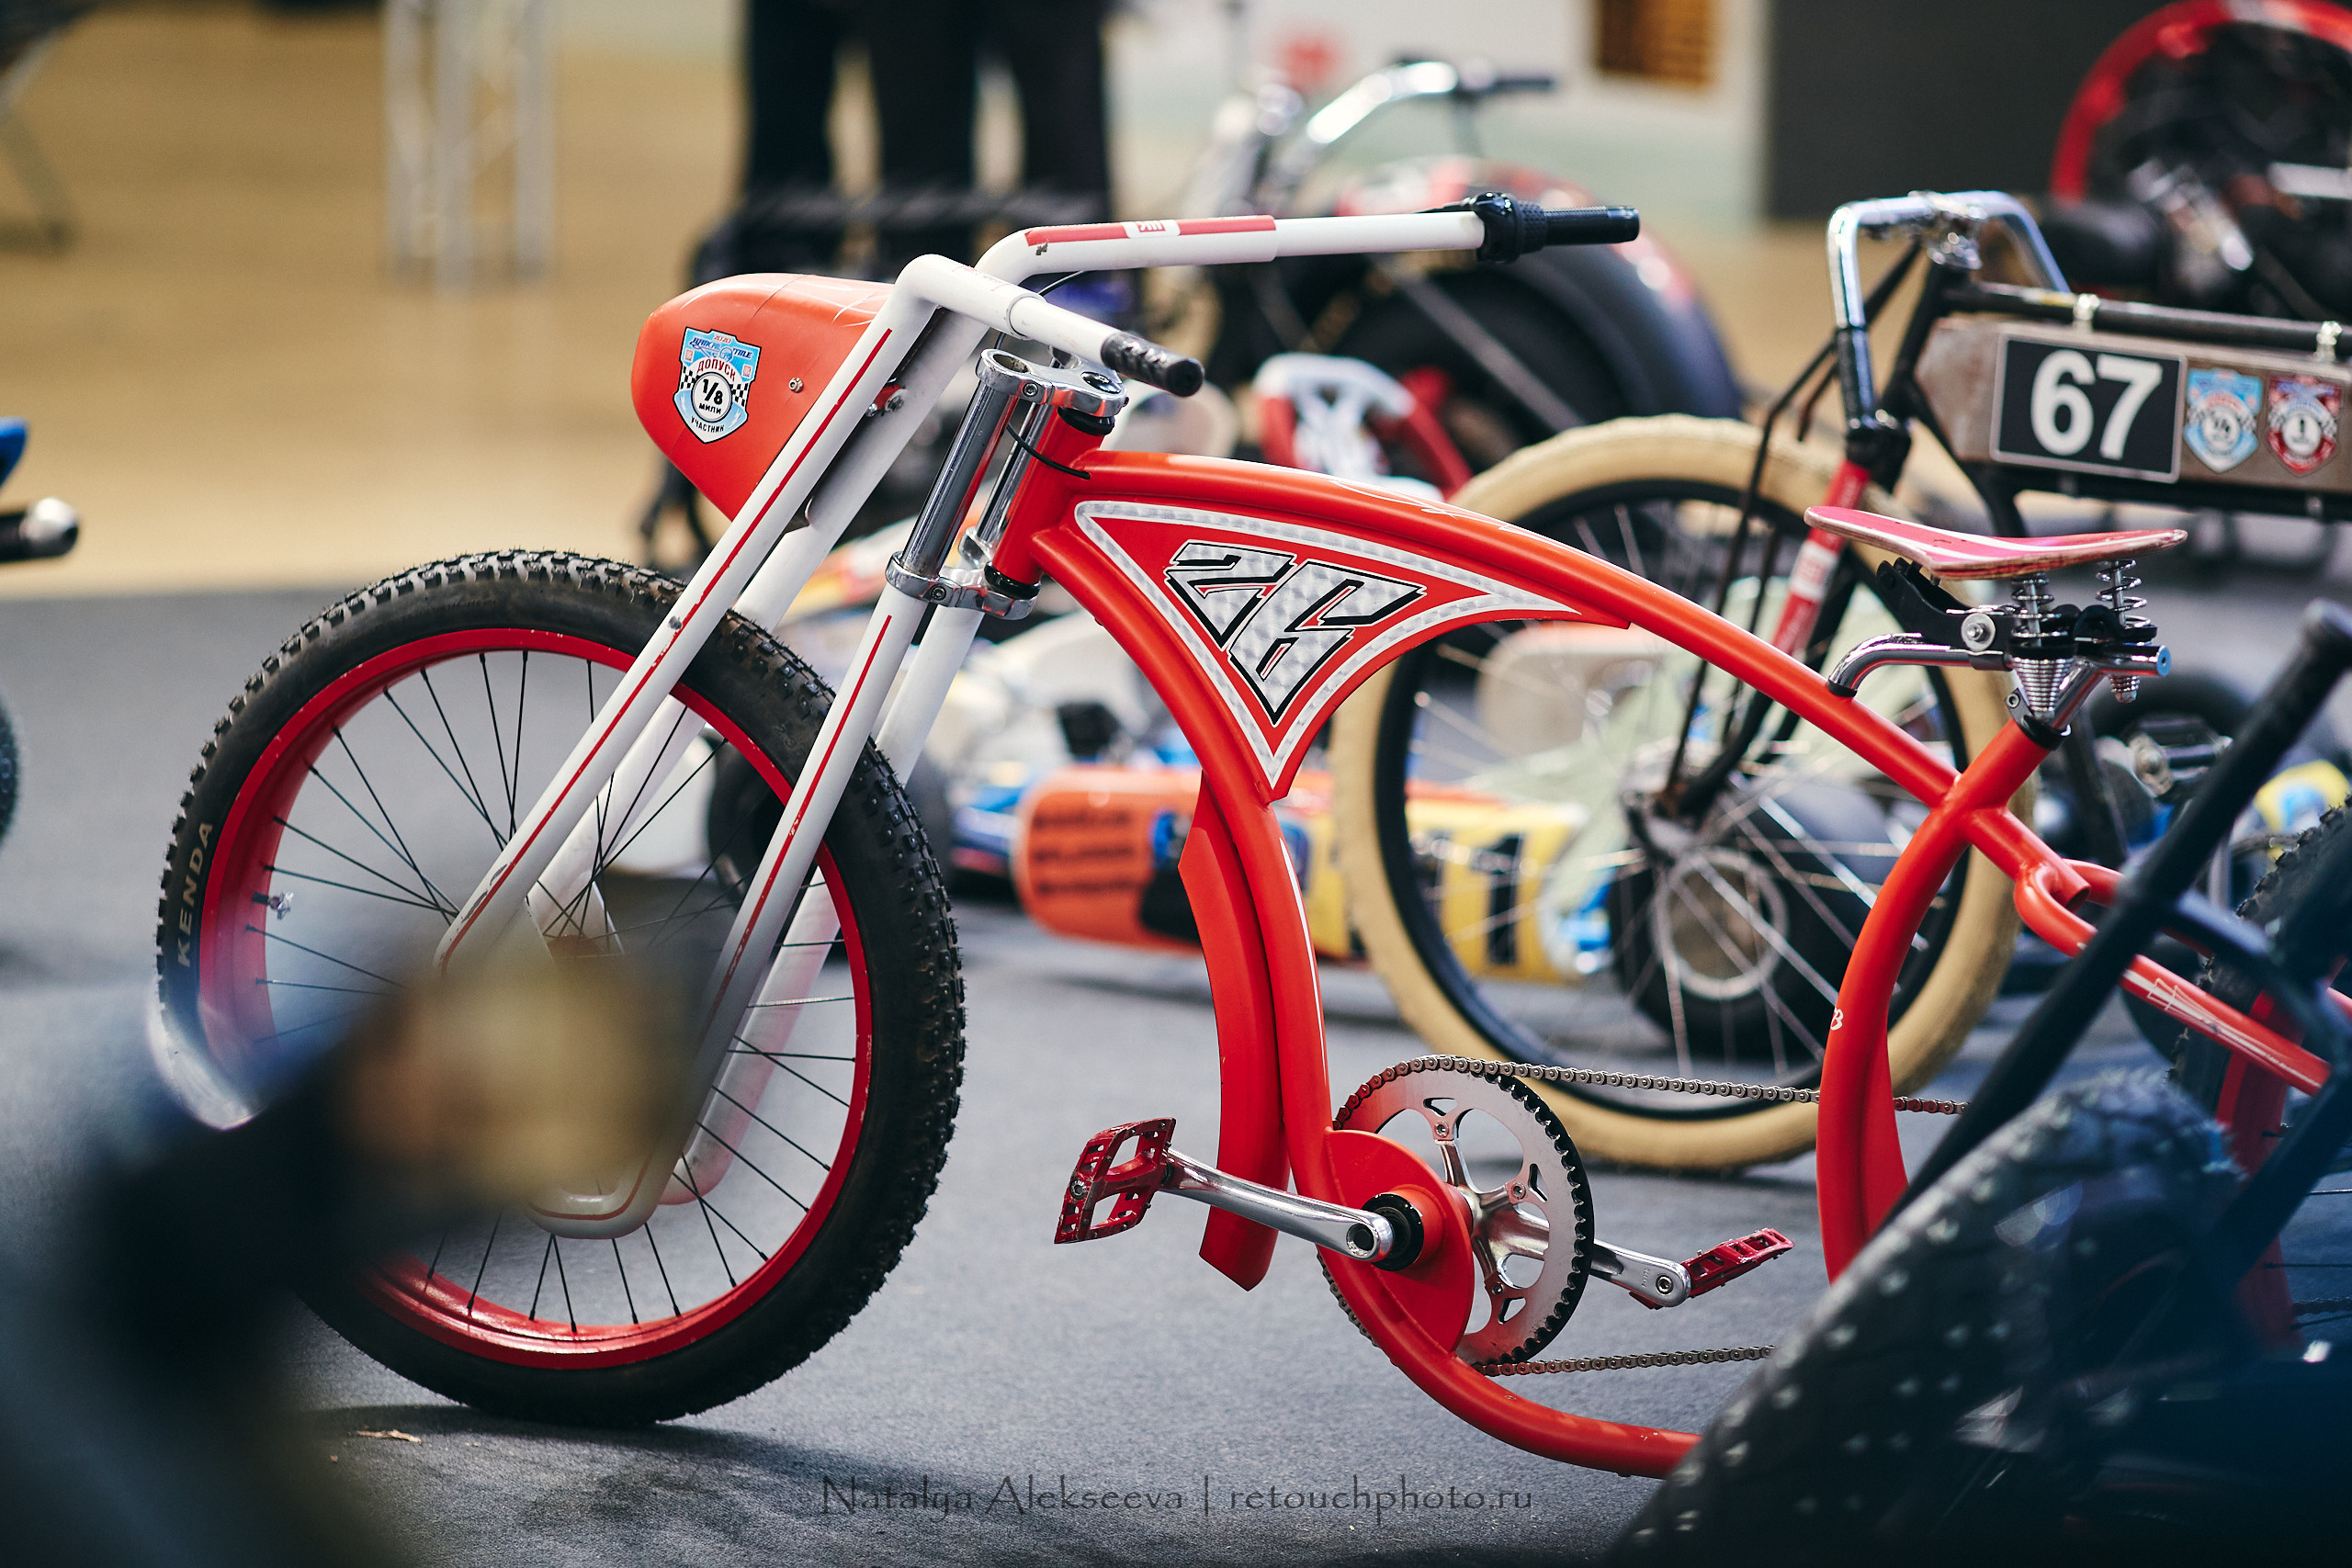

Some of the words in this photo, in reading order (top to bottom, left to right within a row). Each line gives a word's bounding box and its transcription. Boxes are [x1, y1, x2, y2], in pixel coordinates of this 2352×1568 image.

[696, 358, 735, 381] ДОПУСК
[703, 378, 723, 405] 1/8
[2030, 349, 2164, 460] 67
[691, 415, 725, 434] УЧАСТНИК
[176, 822, 214, 968] KENDA
